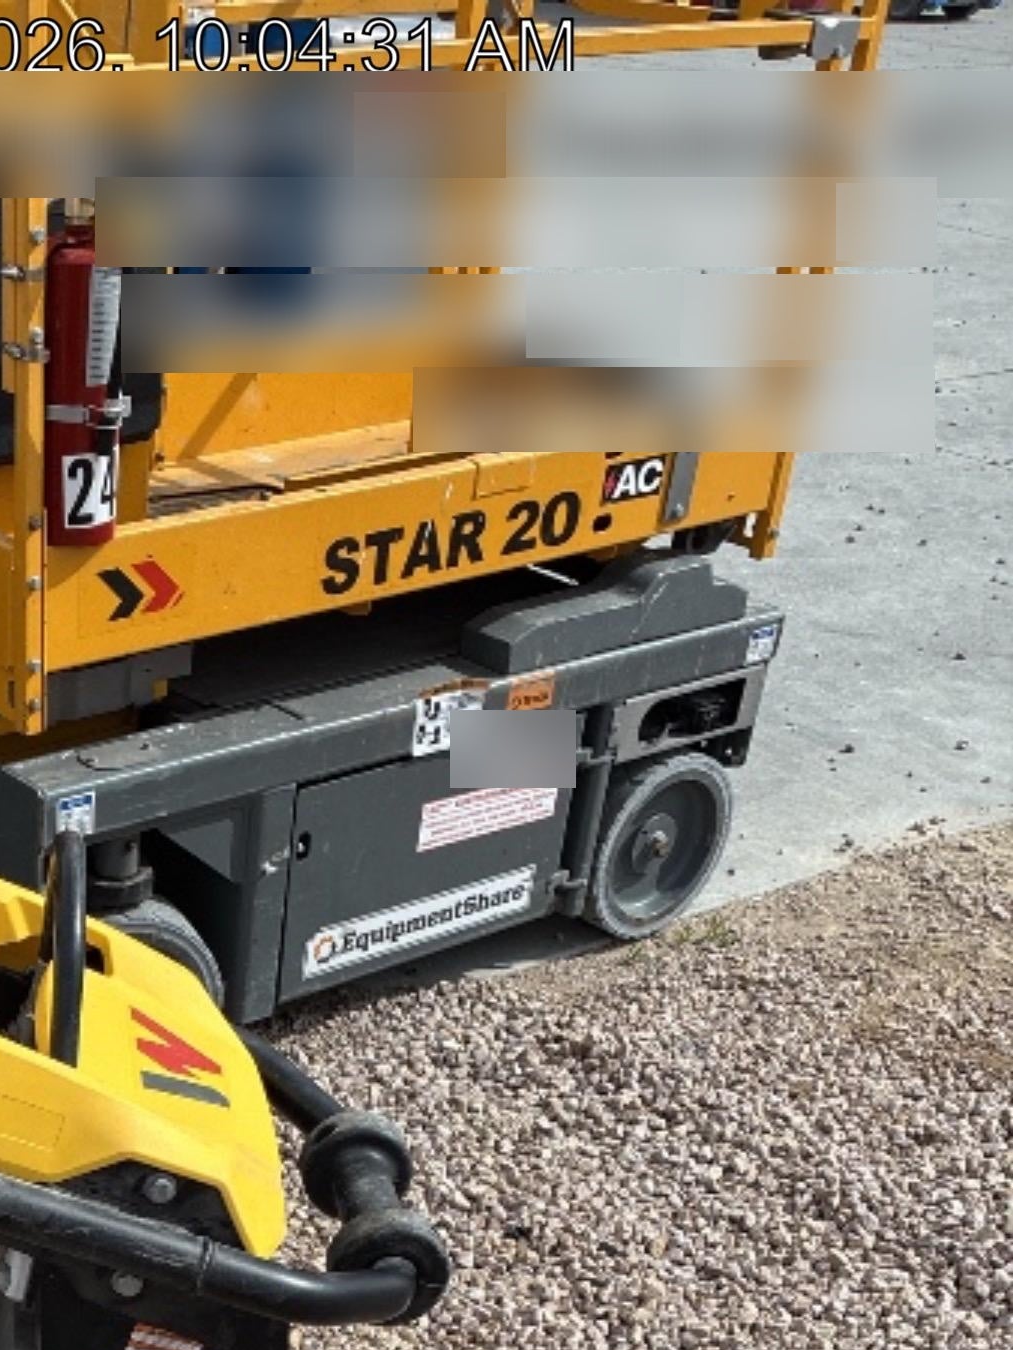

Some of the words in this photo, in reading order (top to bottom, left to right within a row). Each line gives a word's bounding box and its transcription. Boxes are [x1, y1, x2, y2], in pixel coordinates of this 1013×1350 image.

[612, 462, 663, 499] AC
[321, 510, 487, 596] STAR
[500, 491, 580, 555] 20
[342, 882, 527, 951] EquipmentShare
